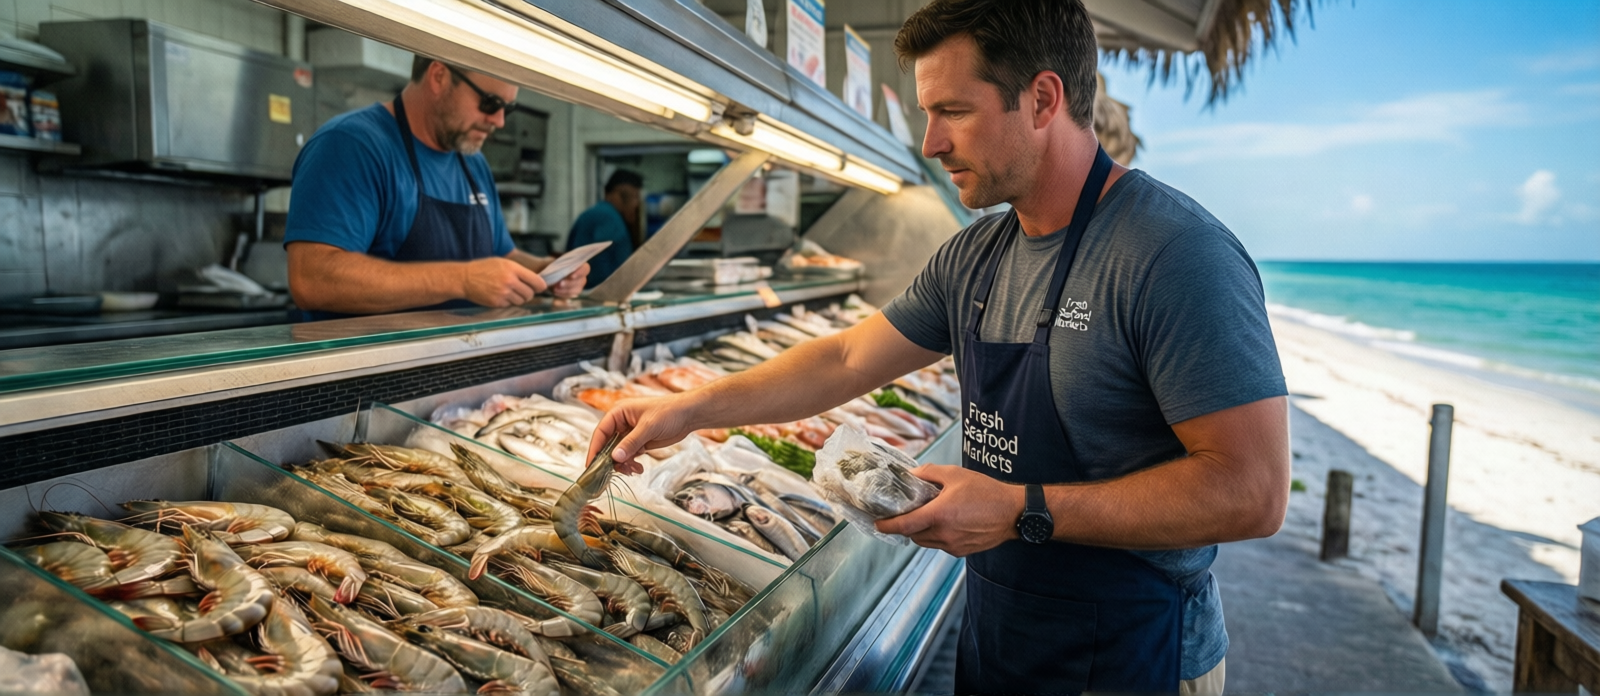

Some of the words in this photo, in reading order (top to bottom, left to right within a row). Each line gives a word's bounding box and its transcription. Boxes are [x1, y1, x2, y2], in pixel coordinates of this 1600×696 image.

[969, 401, 1004, 431] Fresh
[963, 436, 1013, 474] Markets
[964, 417, 1018, 455] Seafood
